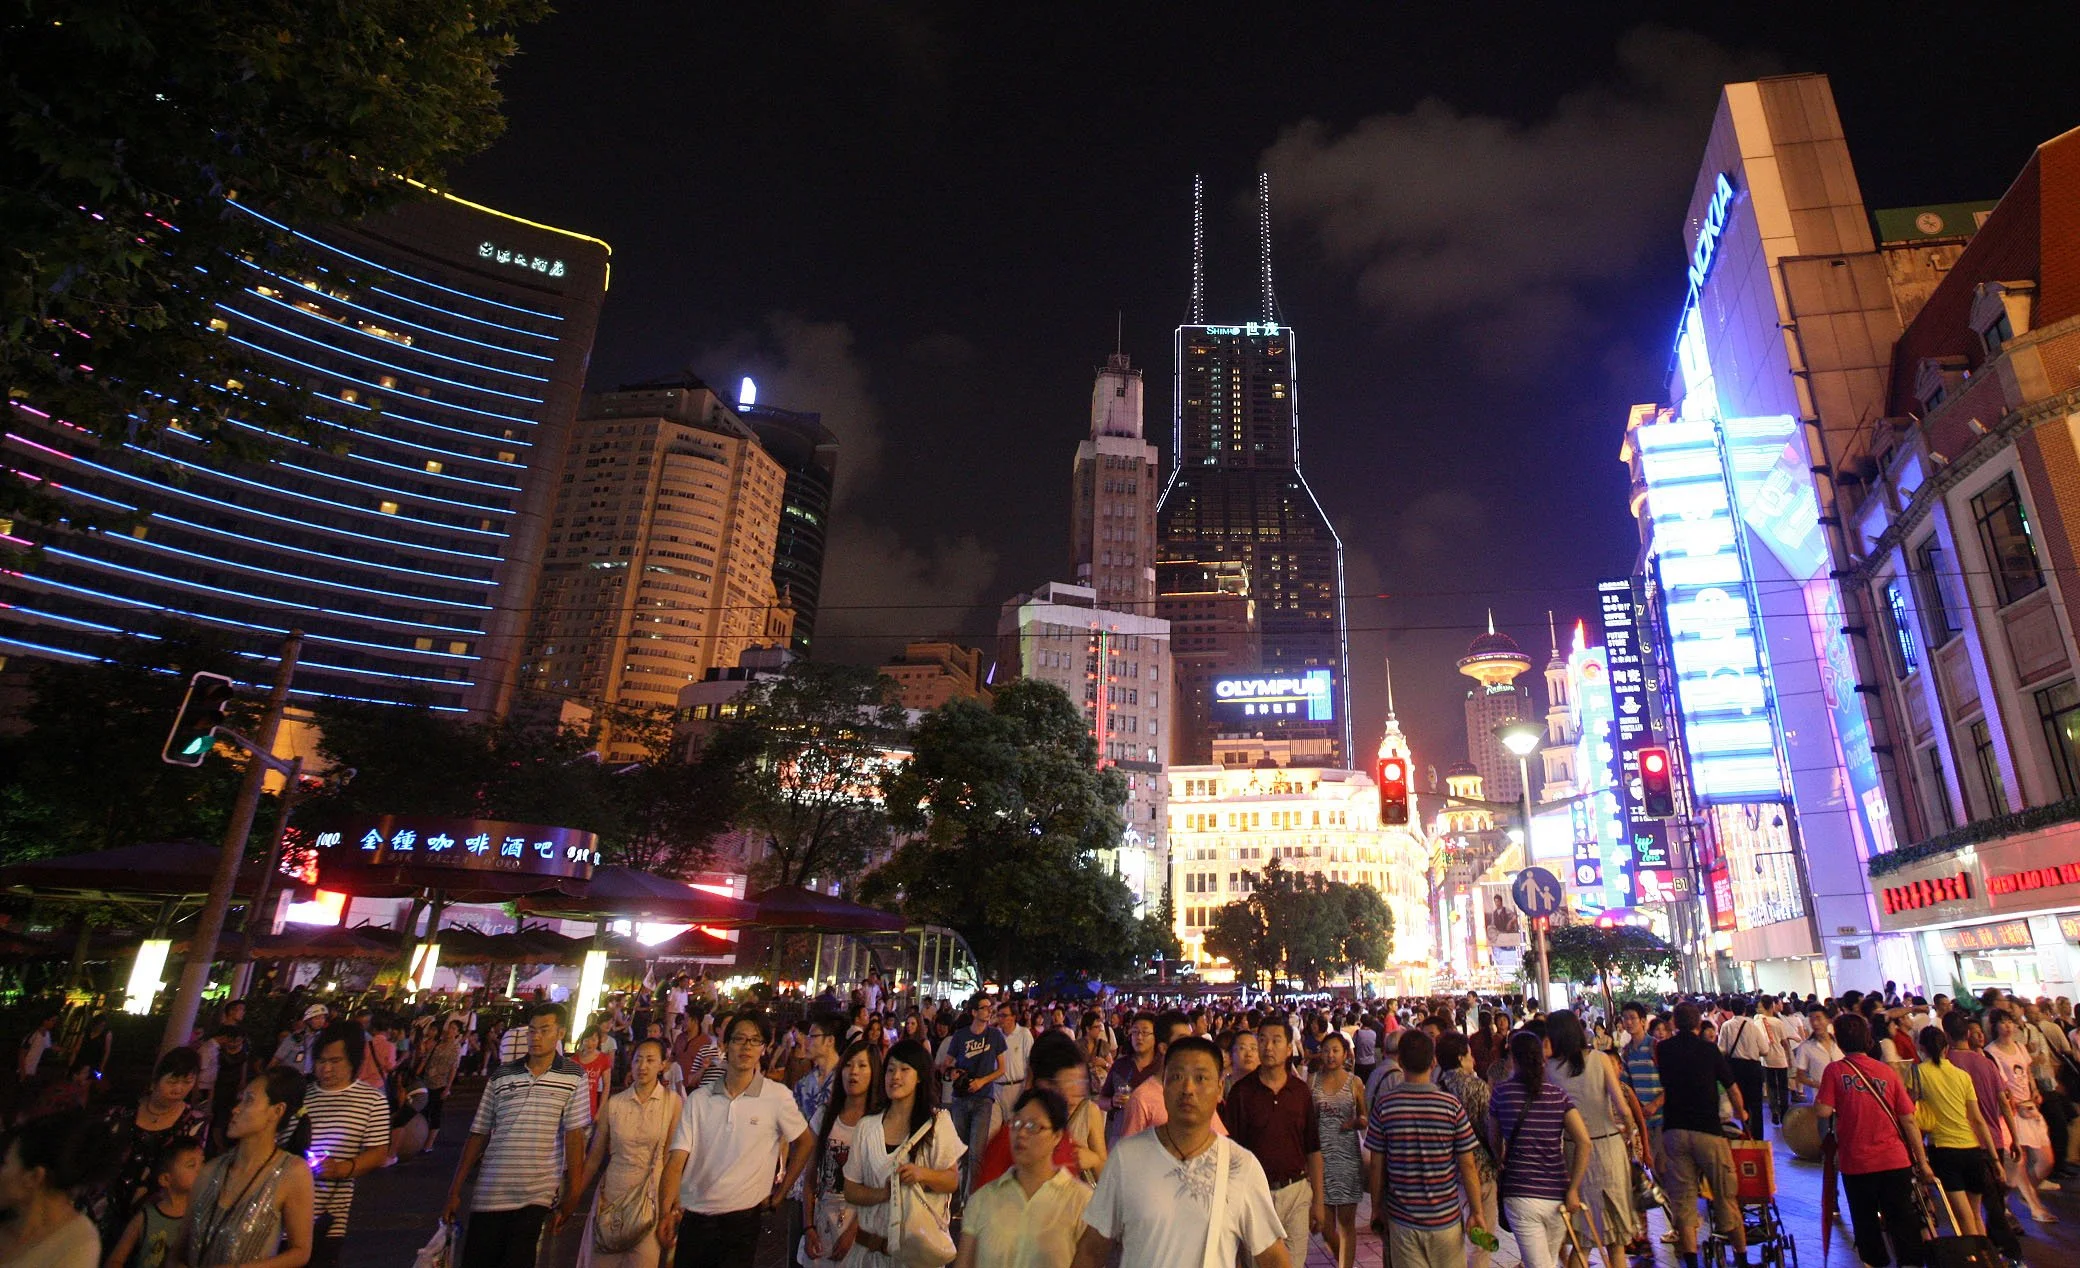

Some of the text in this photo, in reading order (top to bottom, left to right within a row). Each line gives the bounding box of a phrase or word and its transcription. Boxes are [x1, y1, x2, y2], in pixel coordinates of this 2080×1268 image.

[1689, 172, 1732, 301] NOKIA
[1246, 321, 1279, 336] 世茂
[1636, 604, 1645, 616] 7
[1642, 641, 1652, 654] 6
[1647, 679, 1657, 691] 5
[1653, 719, 1664, 731] 4
[1672, 841, 1679, 854] 1
[1673, 878, 1688, 891] B1
[2015, 870, 2041, 891] LAO
[2040, 867, 2061, 887] DA
